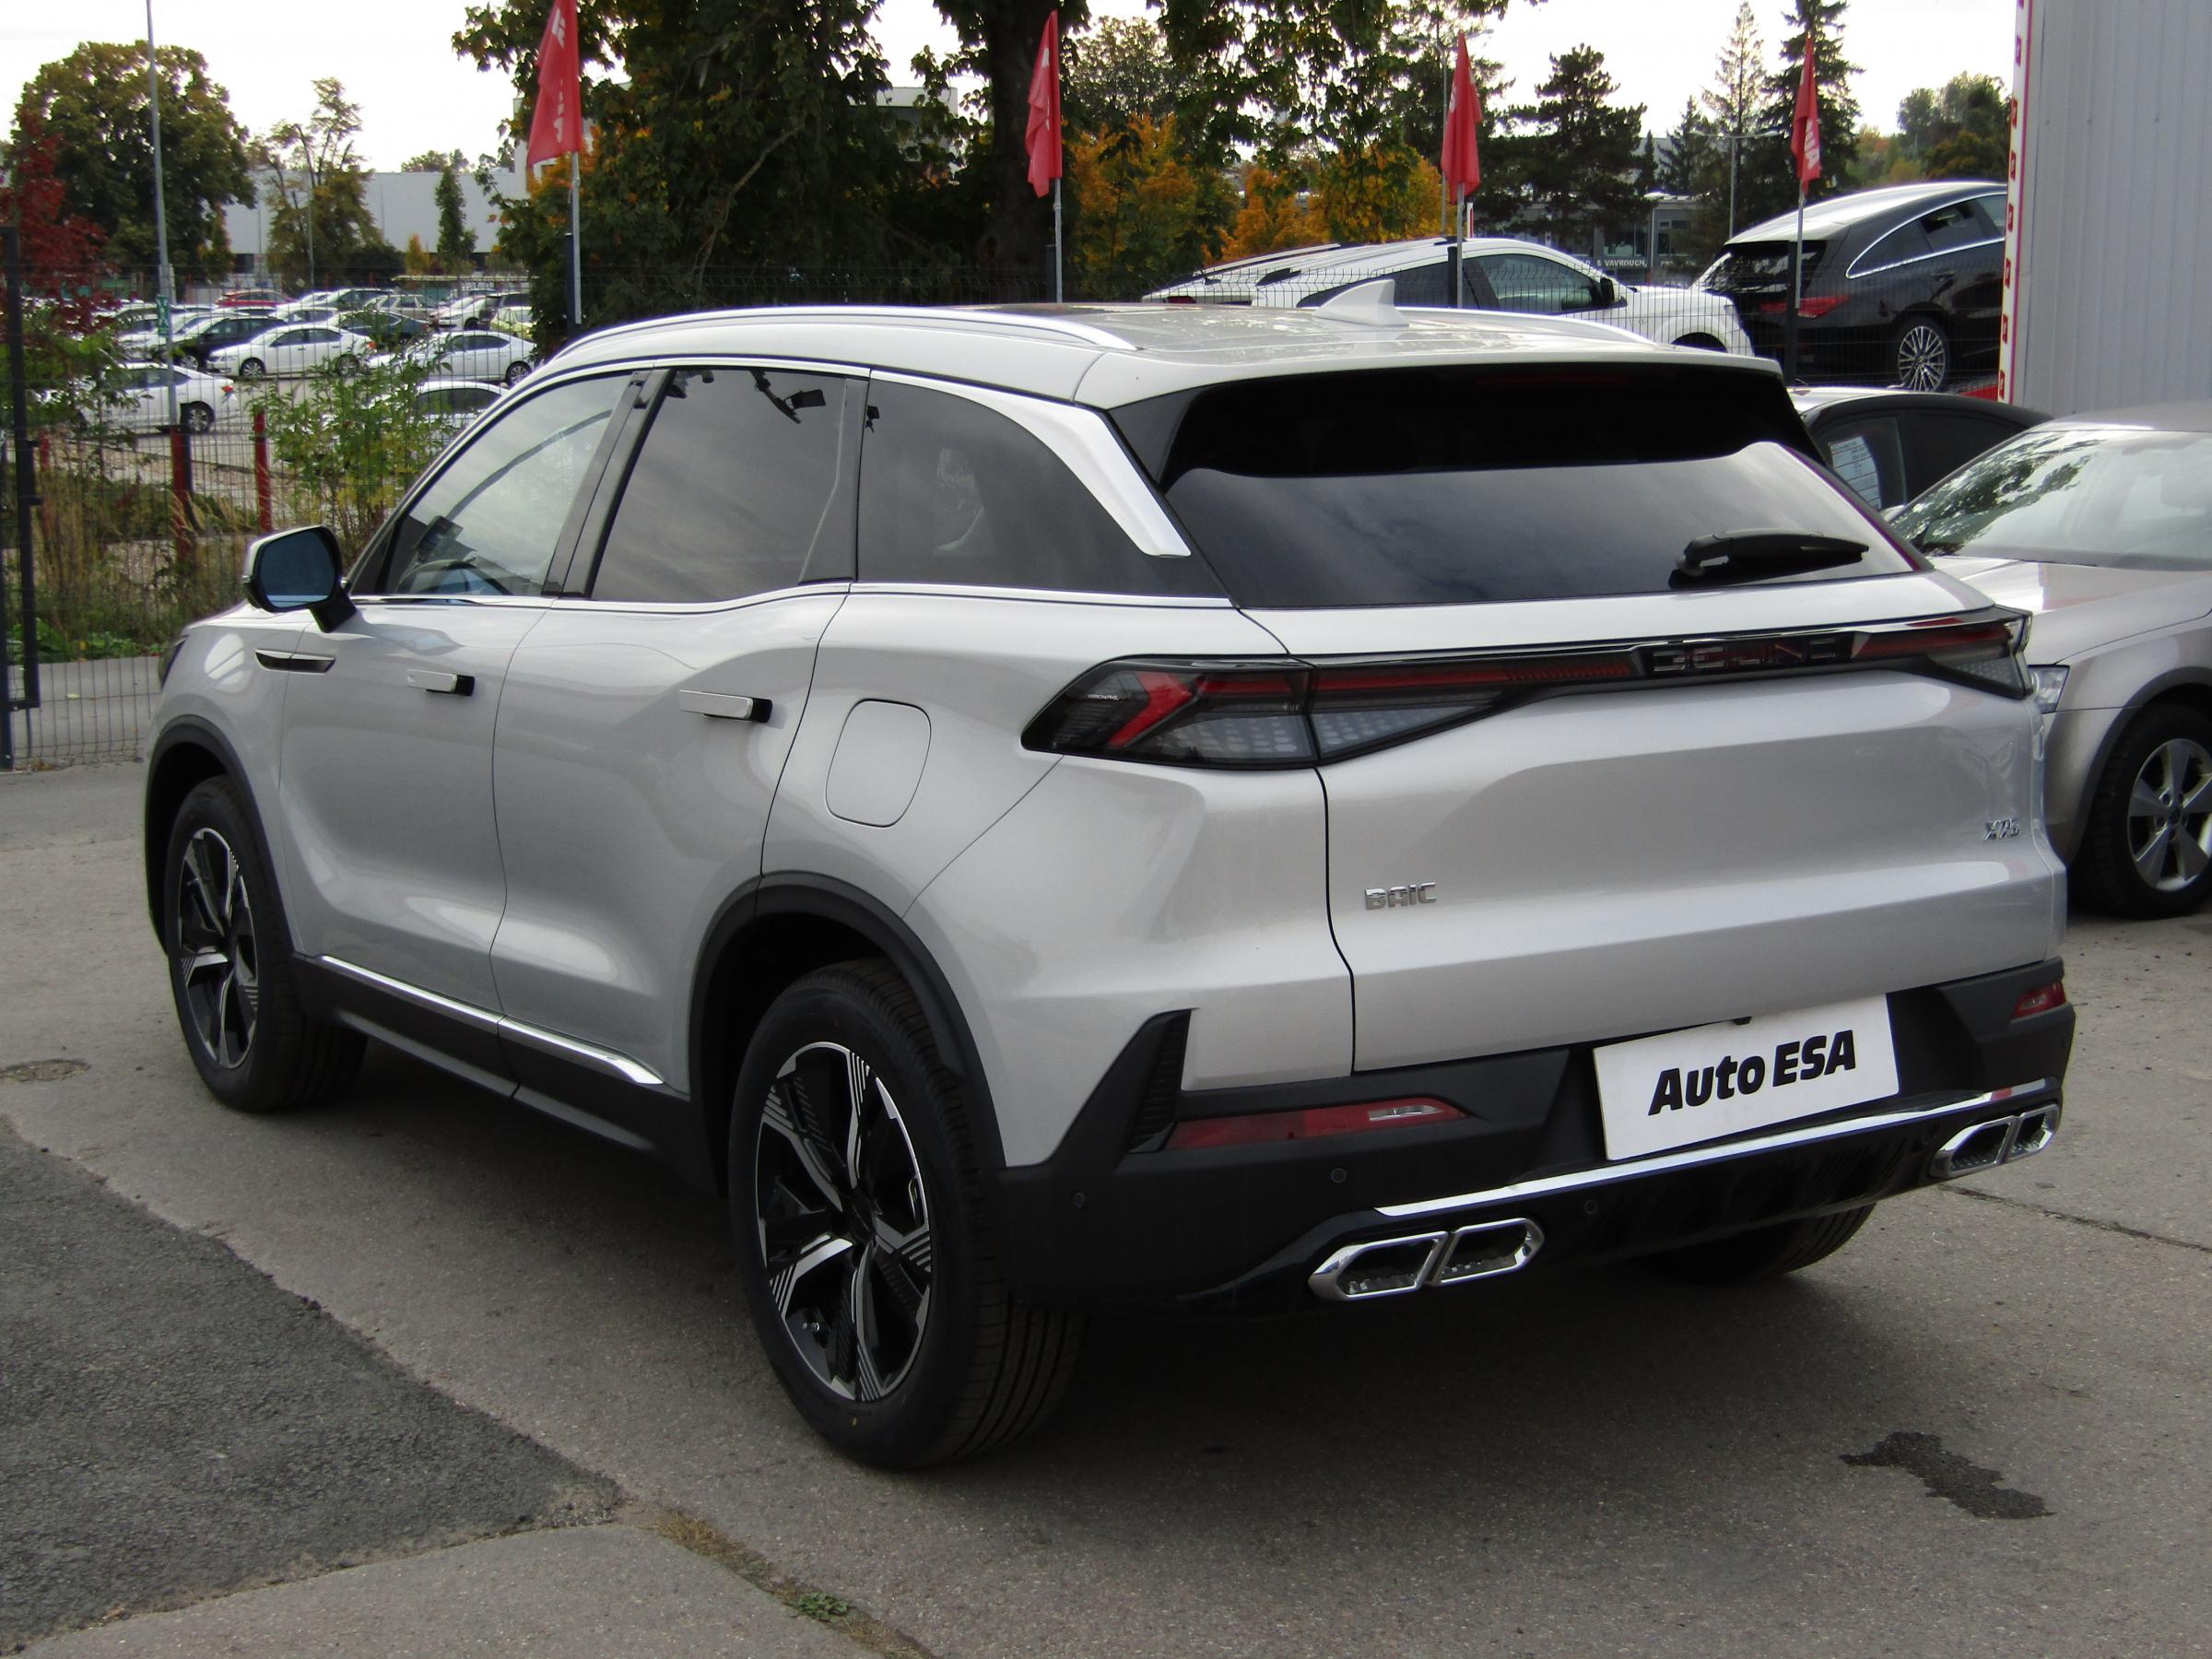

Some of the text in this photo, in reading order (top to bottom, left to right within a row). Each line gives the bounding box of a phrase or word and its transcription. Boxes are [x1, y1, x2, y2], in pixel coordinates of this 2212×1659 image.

[1365, 881, 1437, 911] BAIC
[1648, 1030, 1856, 1116] Auto ESA
